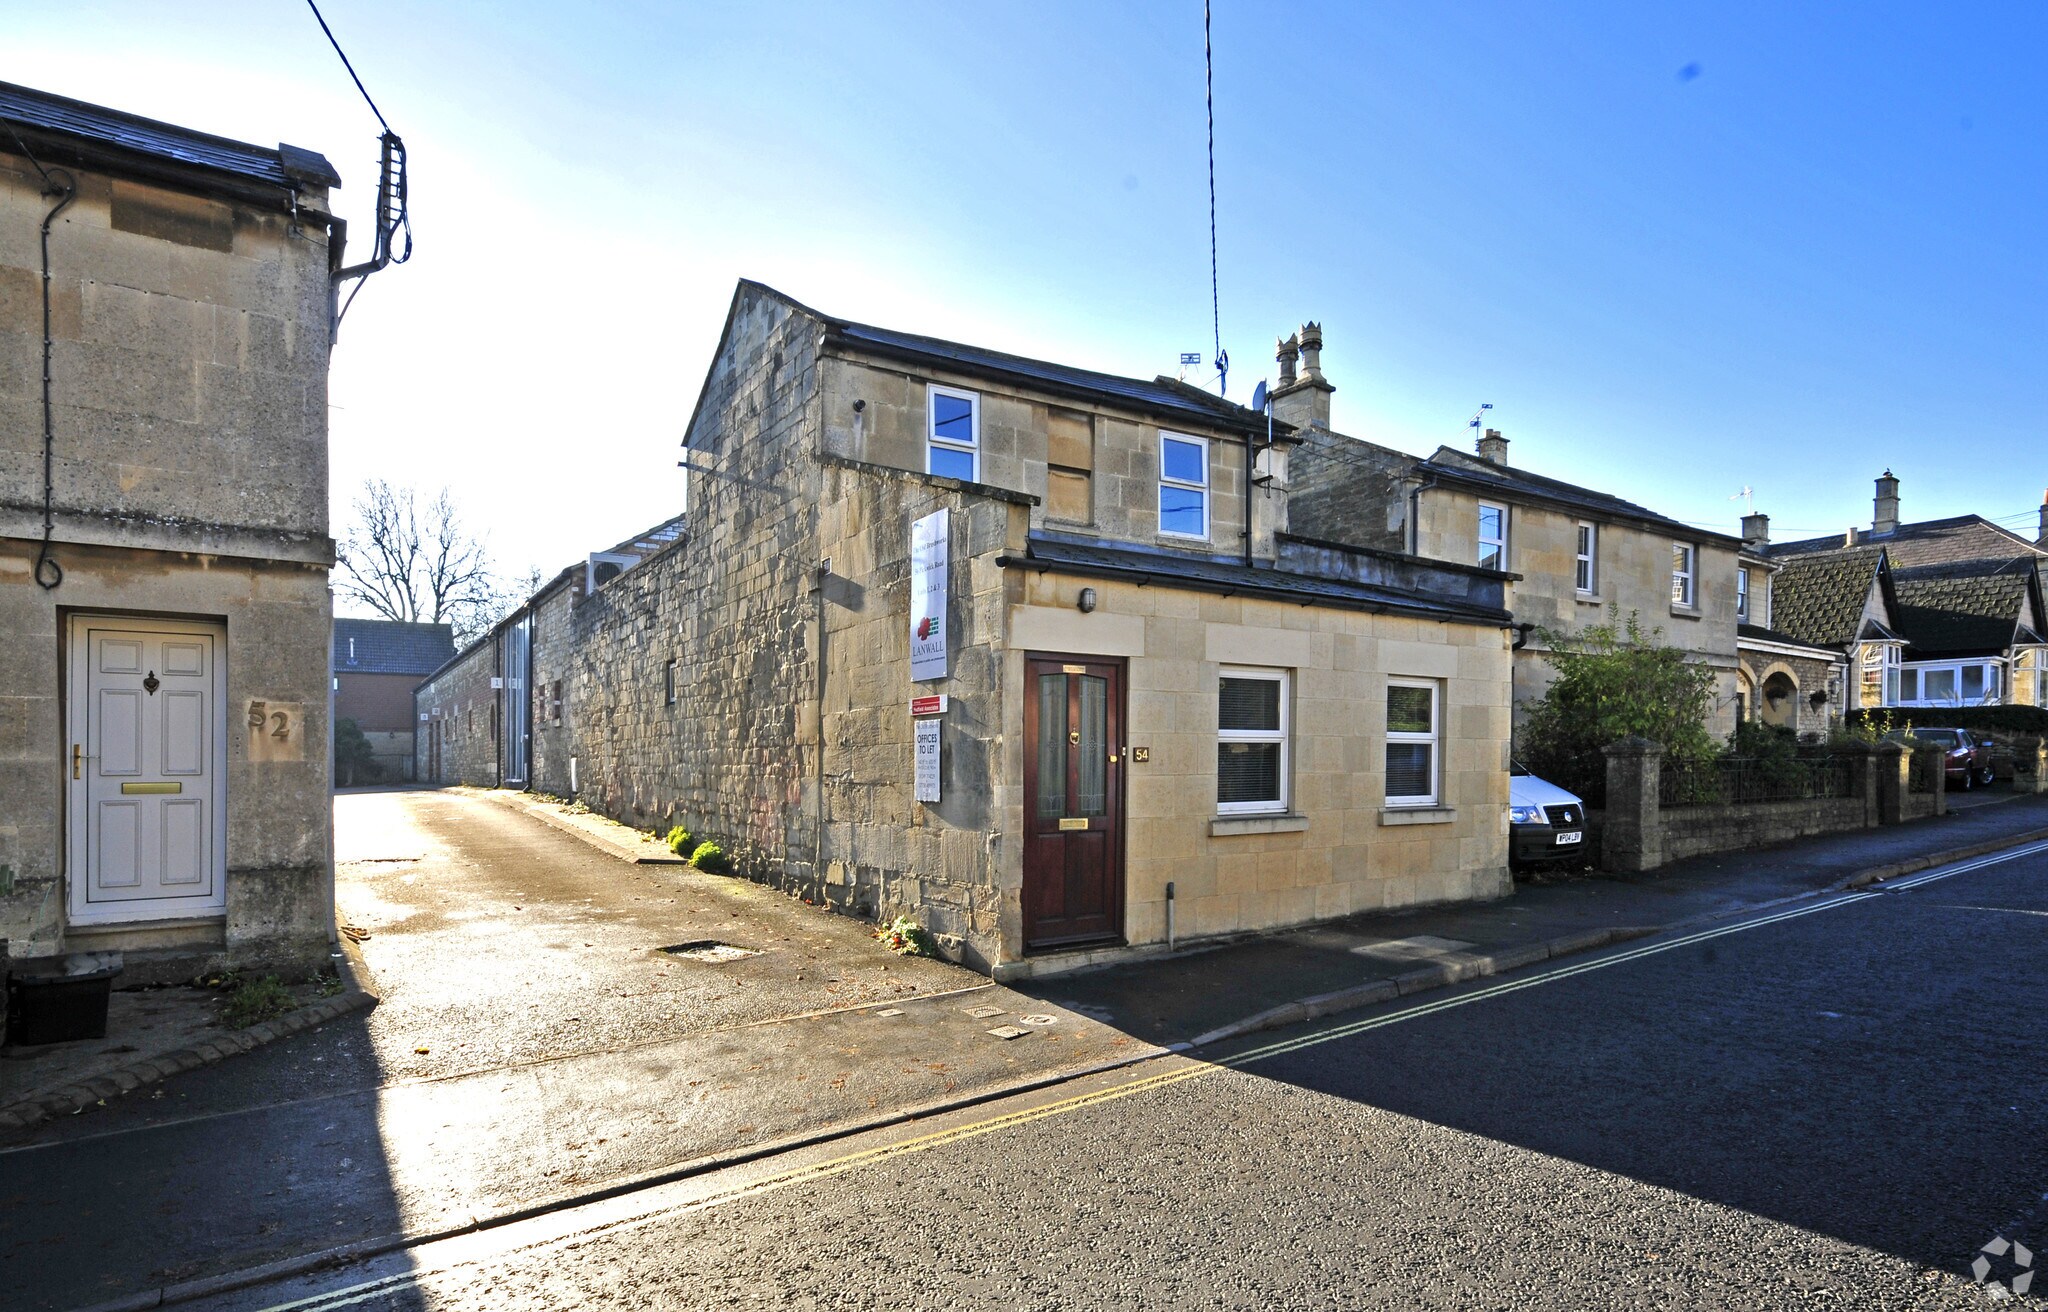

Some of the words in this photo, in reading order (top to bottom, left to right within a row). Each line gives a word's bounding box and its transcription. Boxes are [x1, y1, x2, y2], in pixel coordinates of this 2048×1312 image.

[912, 641, 943, 656] LANWALL
[247, 700, 290, 737] 52
[917, 733, 938, 744] OFFICES
[919, 745, 926, 755] TO
[927, 745, 935, 755] LET
[1136, 749, 1149, 761] 54
